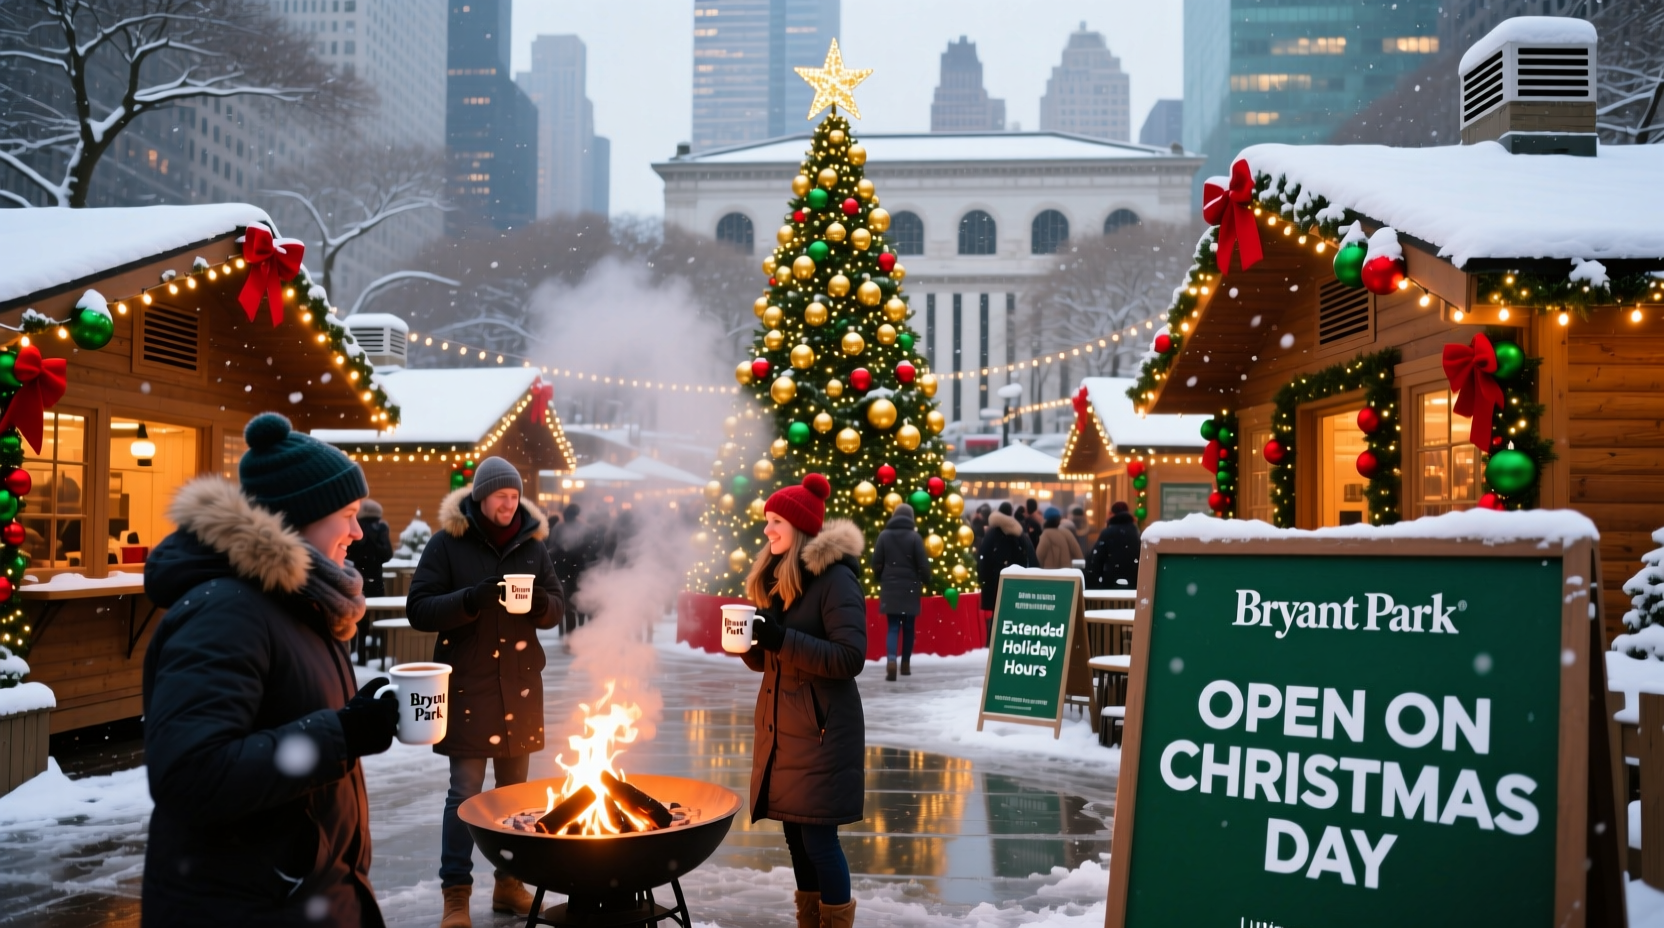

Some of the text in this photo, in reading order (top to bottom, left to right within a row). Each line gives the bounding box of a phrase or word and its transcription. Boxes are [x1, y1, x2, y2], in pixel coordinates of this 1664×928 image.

[1001, 619, 1065, 638] Extended
[1231, 588, 1460, 639] Bryant Park
[1002, 639, 1057, 661] Holiday
[1003, 659, 1047, 677] Hours
[415, 705, 444, 722] Park
[1198, 679, 1491, 754] OPEN ON
[1159, 738, 1539, 835] CHRISTMAS
[1264, 817, 1398, 890] DAY
